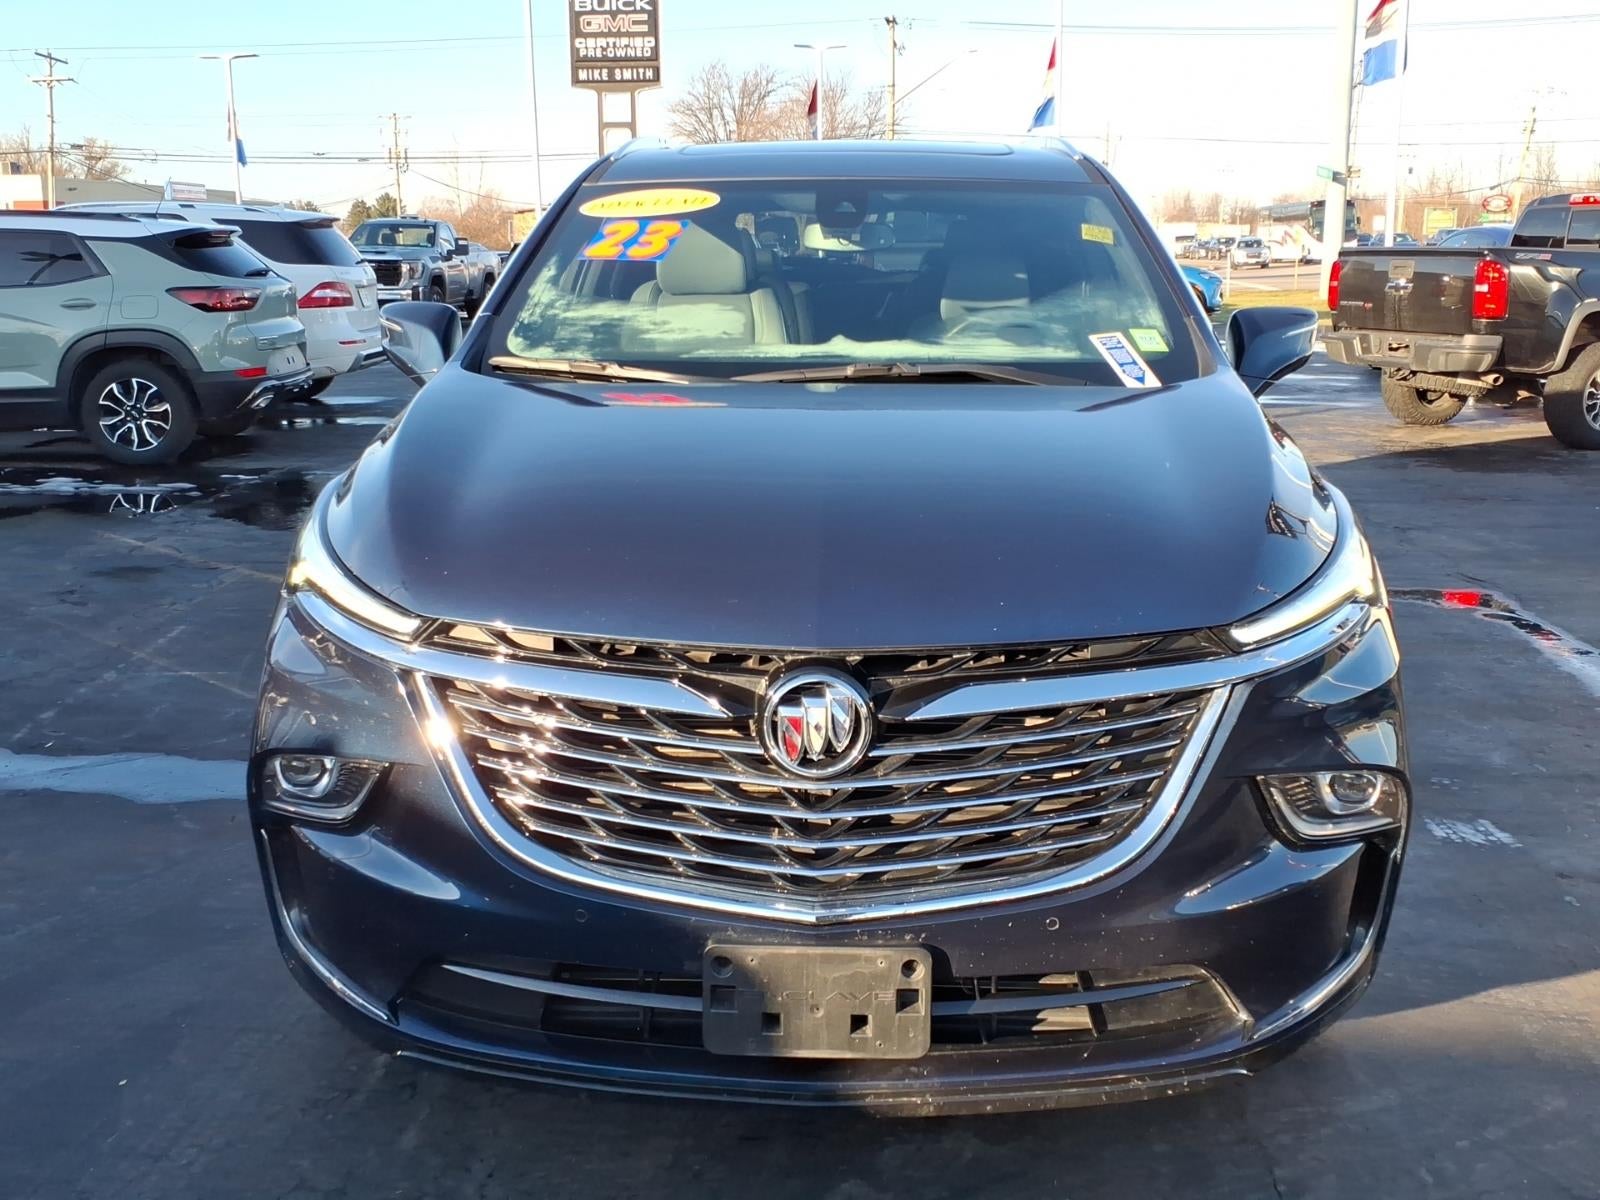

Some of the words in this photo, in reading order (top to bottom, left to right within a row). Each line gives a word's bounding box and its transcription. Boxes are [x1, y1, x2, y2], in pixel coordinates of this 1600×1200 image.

[575, 0, 653, 11] BUICK
[580, 14, 649, 32] GMC
[575, 37, 656, 48] CERTIFIED
[579, 47, 652, 58] PRE-OWNED
[579, 69, 609, 80] MIKE
[615, 68, 654, 80] SMITH
[583, 219, 683, 260] 23
